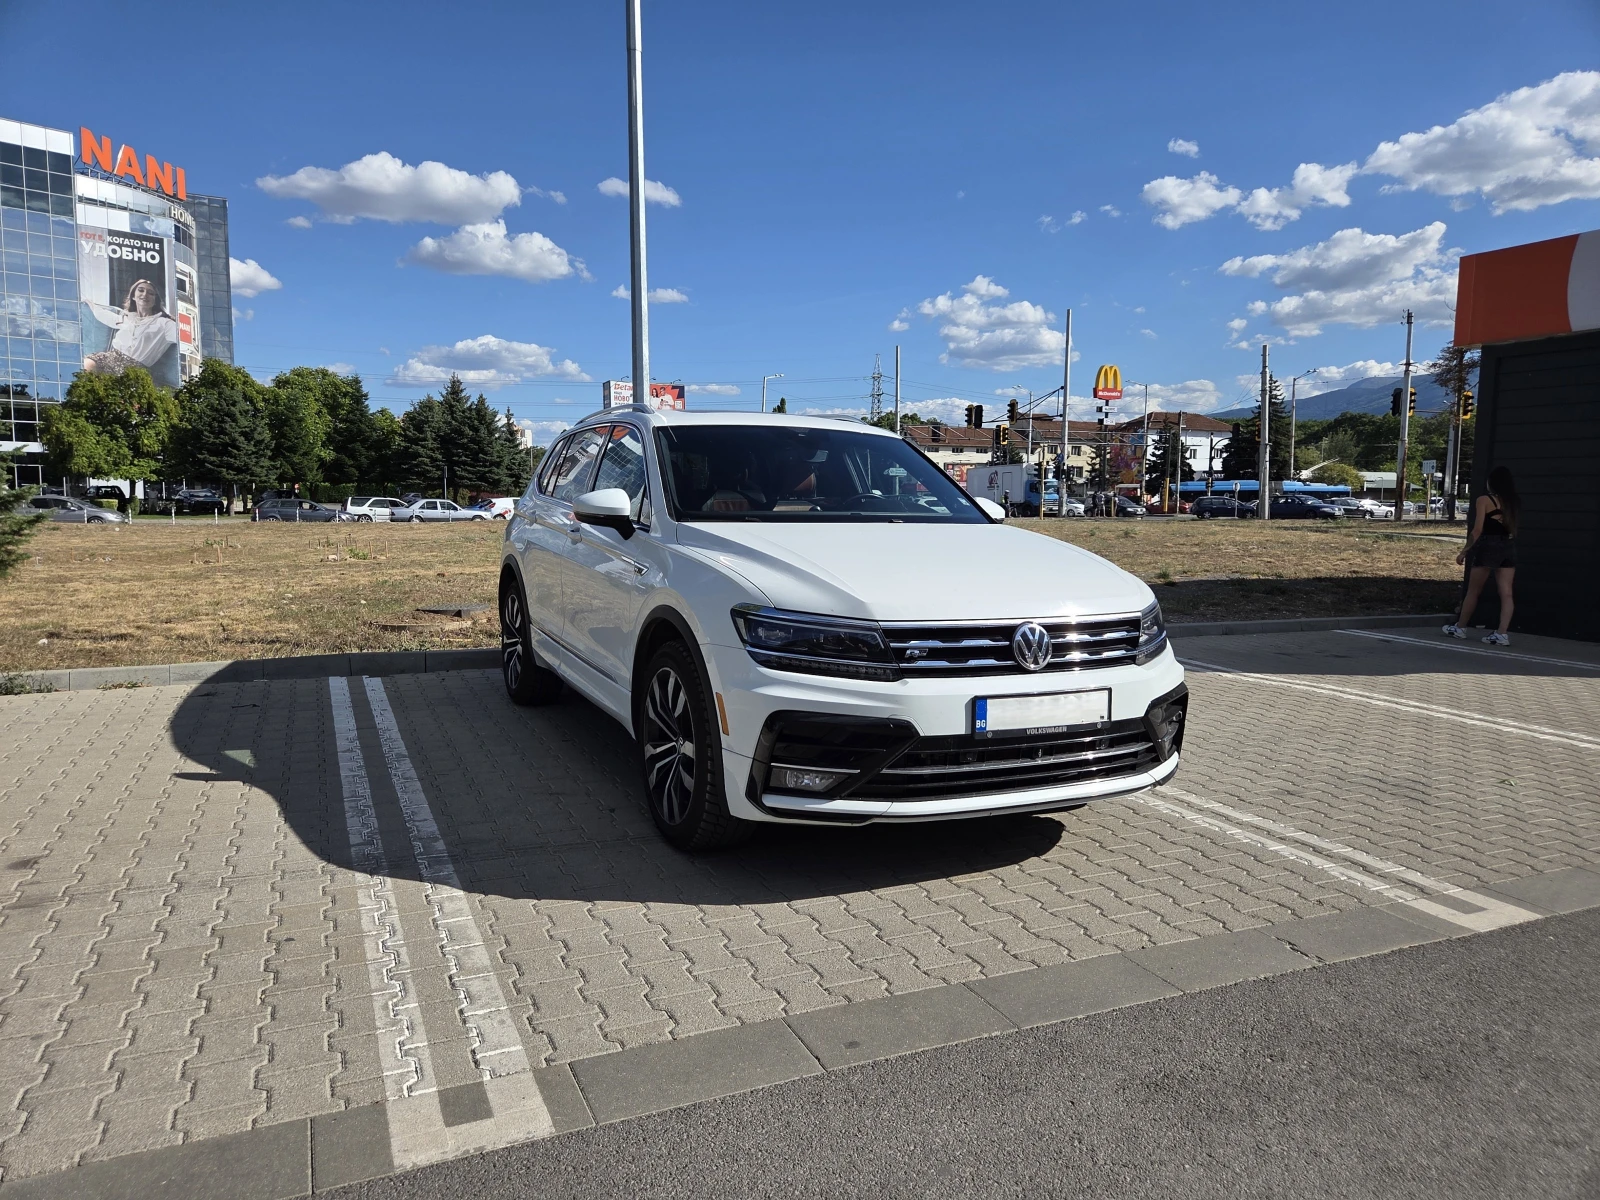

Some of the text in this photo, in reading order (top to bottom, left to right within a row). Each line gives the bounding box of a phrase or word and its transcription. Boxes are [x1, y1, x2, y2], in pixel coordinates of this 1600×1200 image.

[80, 126, 187, 201] NANI
[107, 235, 141, 247] КОГАТО
[142, 241, 153, 249] ТИ
[81, 240, 160, 264] УДОБНО
[976, 720, 986, 728] BG
[1026, 725, 1067, 735] VOLKSWAGEN
